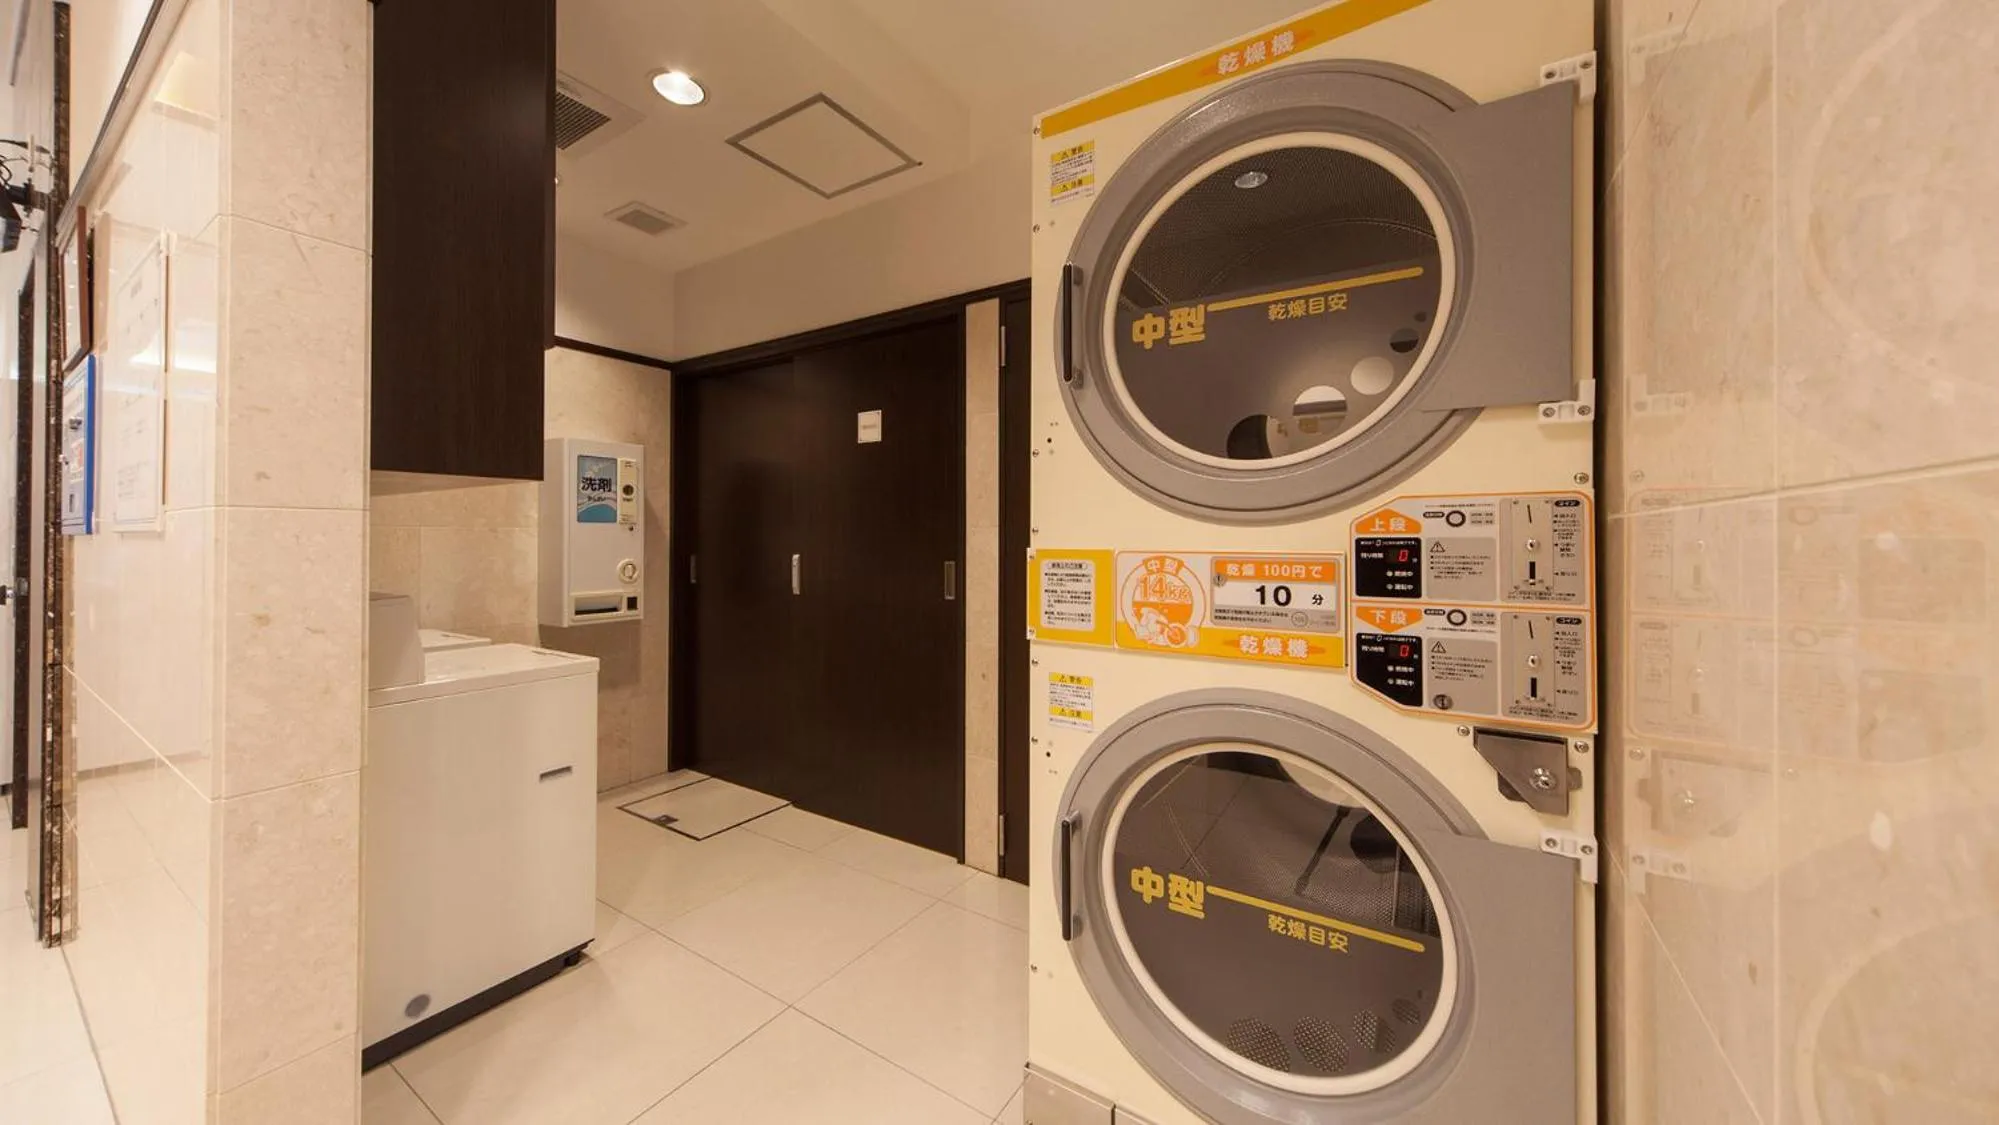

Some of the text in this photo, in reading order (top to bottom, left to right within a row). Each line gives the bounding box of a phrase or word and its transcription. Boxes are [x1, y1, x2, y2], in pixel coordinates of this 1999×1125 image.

[1217, 30, 1294, 75] 乾燥機
[1267, 293, 1347, 321] 乾燥目安
[1132, 304, 1206, 350] 中型
[581, 477, 612, 492] 洗剤
[1369, 516, 1408, 532] 上段
[1147, 558, 1178, 574] 中型
[1264, 564, 1323, 579] 100円で
[1255, 585, 1324, 606] 10 分
[1369, 608, 1407, 626] 下段
[1239, 633, 1309, 659] 乾燥機
[1131, 866, 1205, 920] 中型
[1268, 914, 1349, 953] 乾燥目安
